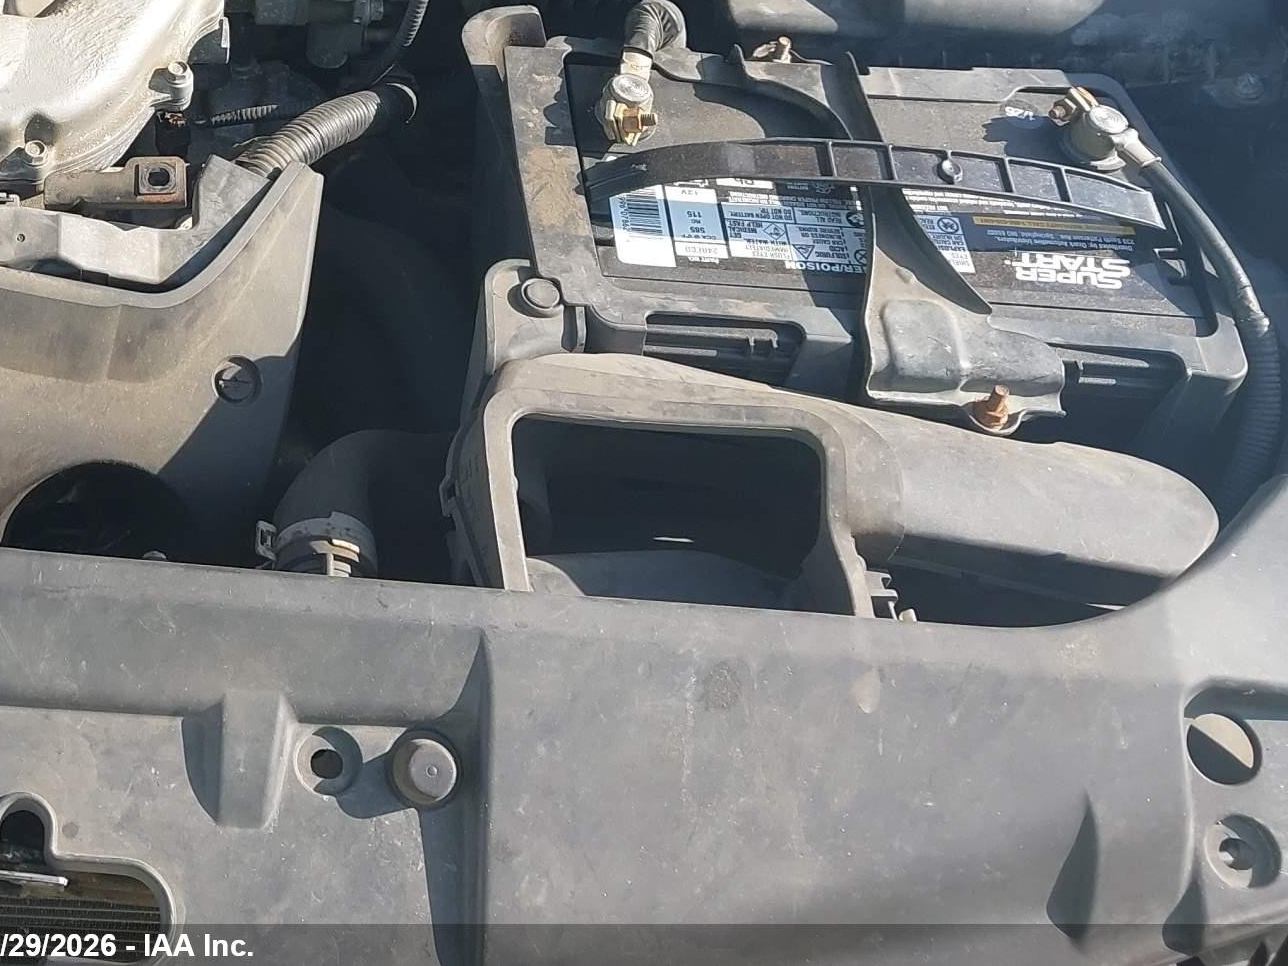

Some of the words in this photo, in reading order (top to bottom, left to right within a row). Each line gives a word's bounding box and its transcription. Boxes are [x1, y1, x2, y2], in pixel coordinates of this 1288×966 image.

[686, 210, 703, 218] 115
[689, 226, 705, 234] 585
[784, 260, 863, 274] ER/POISON
[1010, 253, 1131, 277] START
[1016, 267, 1122, 290] SUPER
